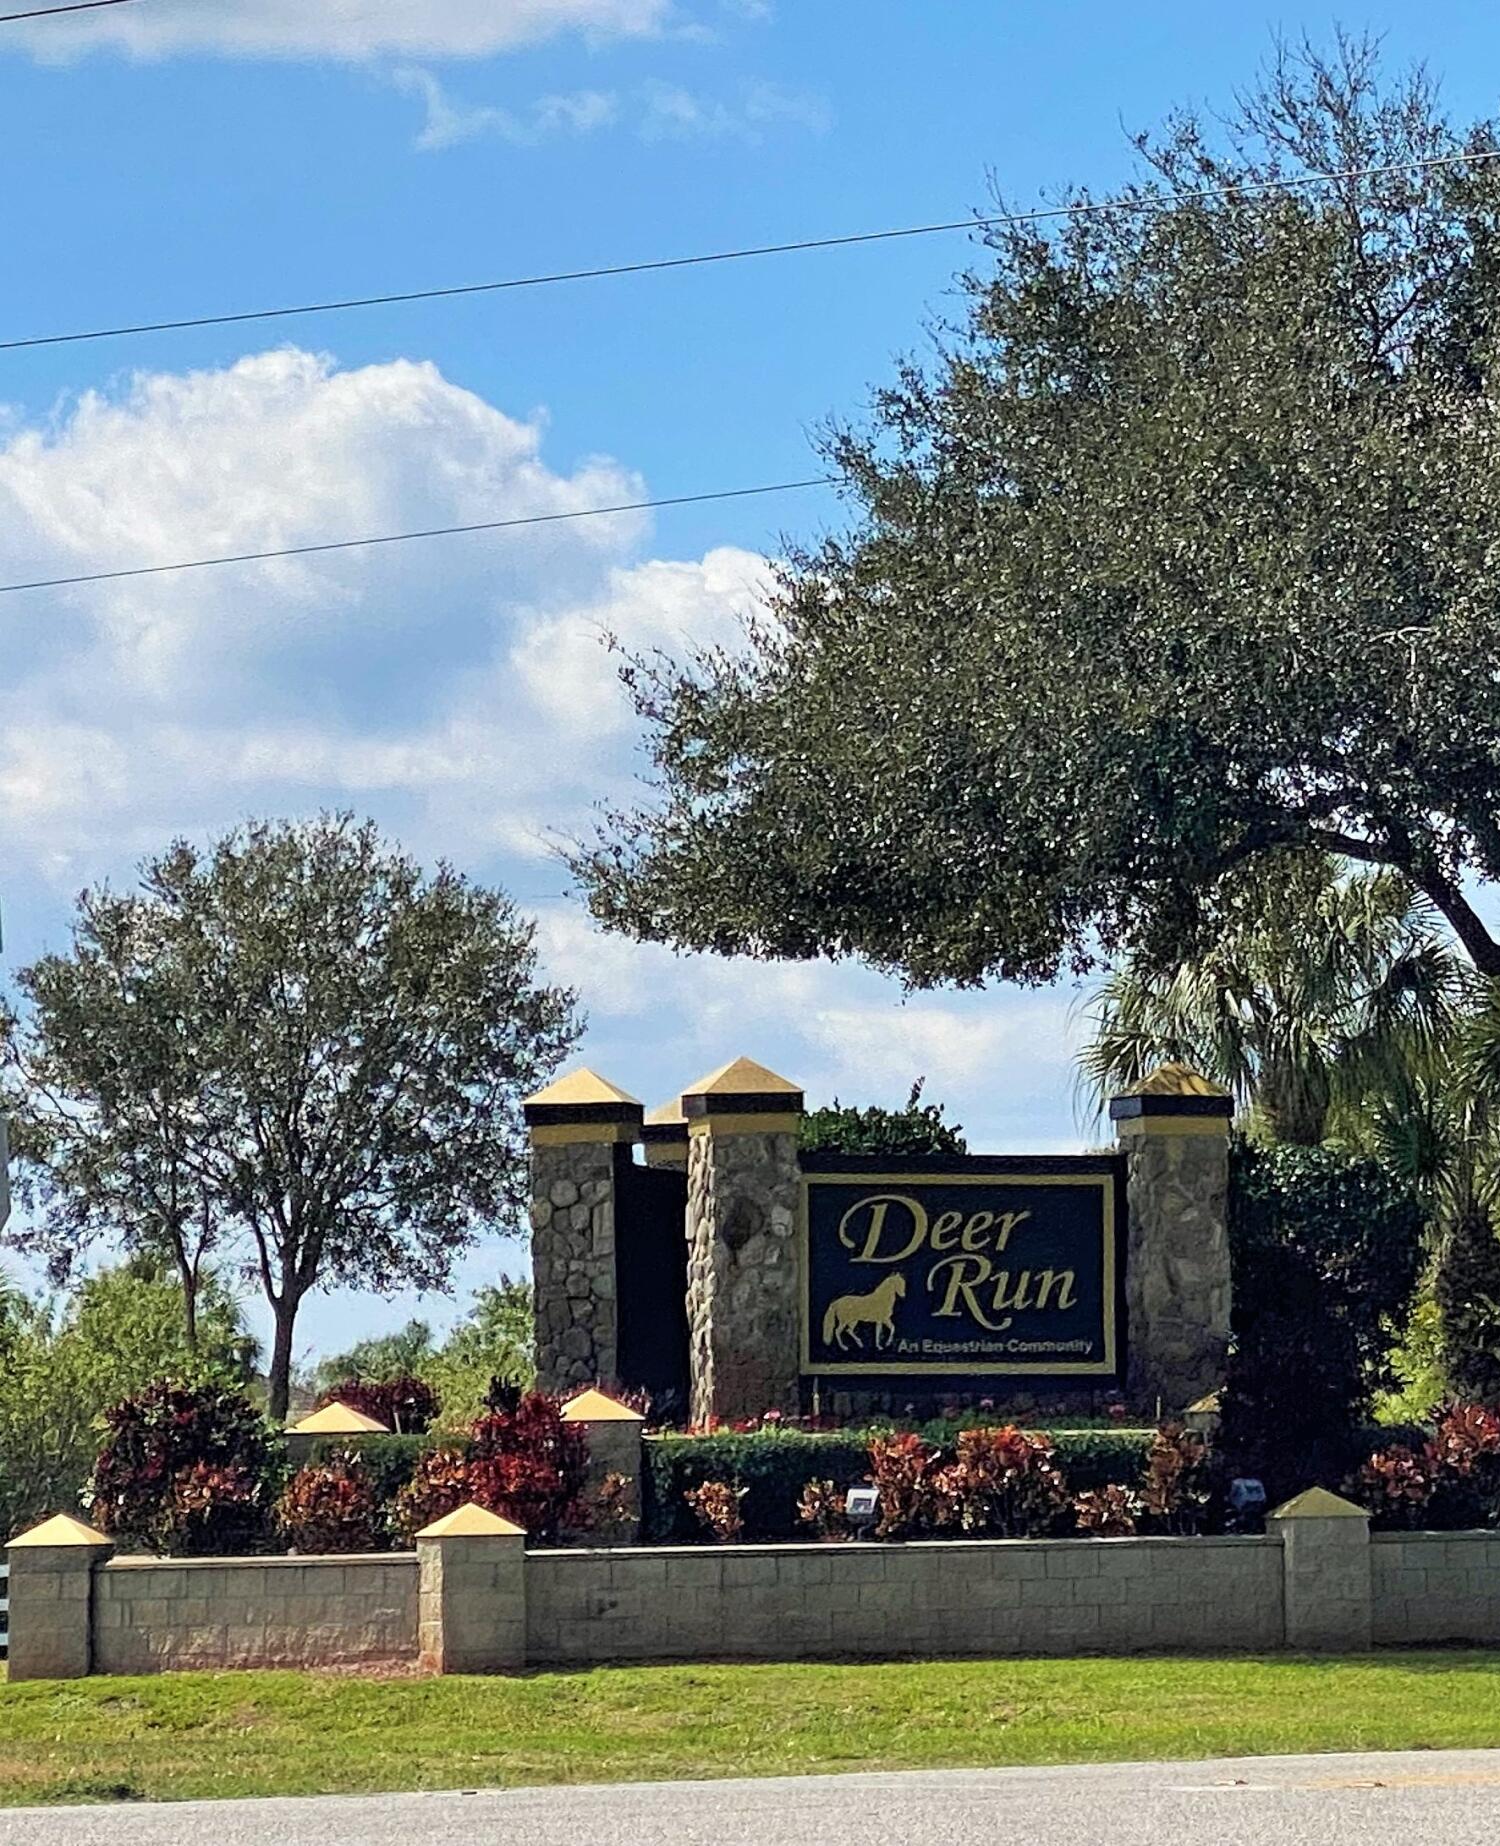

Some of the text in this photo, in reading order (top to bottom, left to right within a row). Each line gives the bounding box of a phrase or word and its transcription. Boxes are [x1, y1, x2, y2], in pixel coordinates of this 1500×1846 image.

[839, 1194, 1030, 1263] Deer
[927, 1254, 1077, 1330] Run
[898, 1338, 1093, 1355] An Equestrian Community
